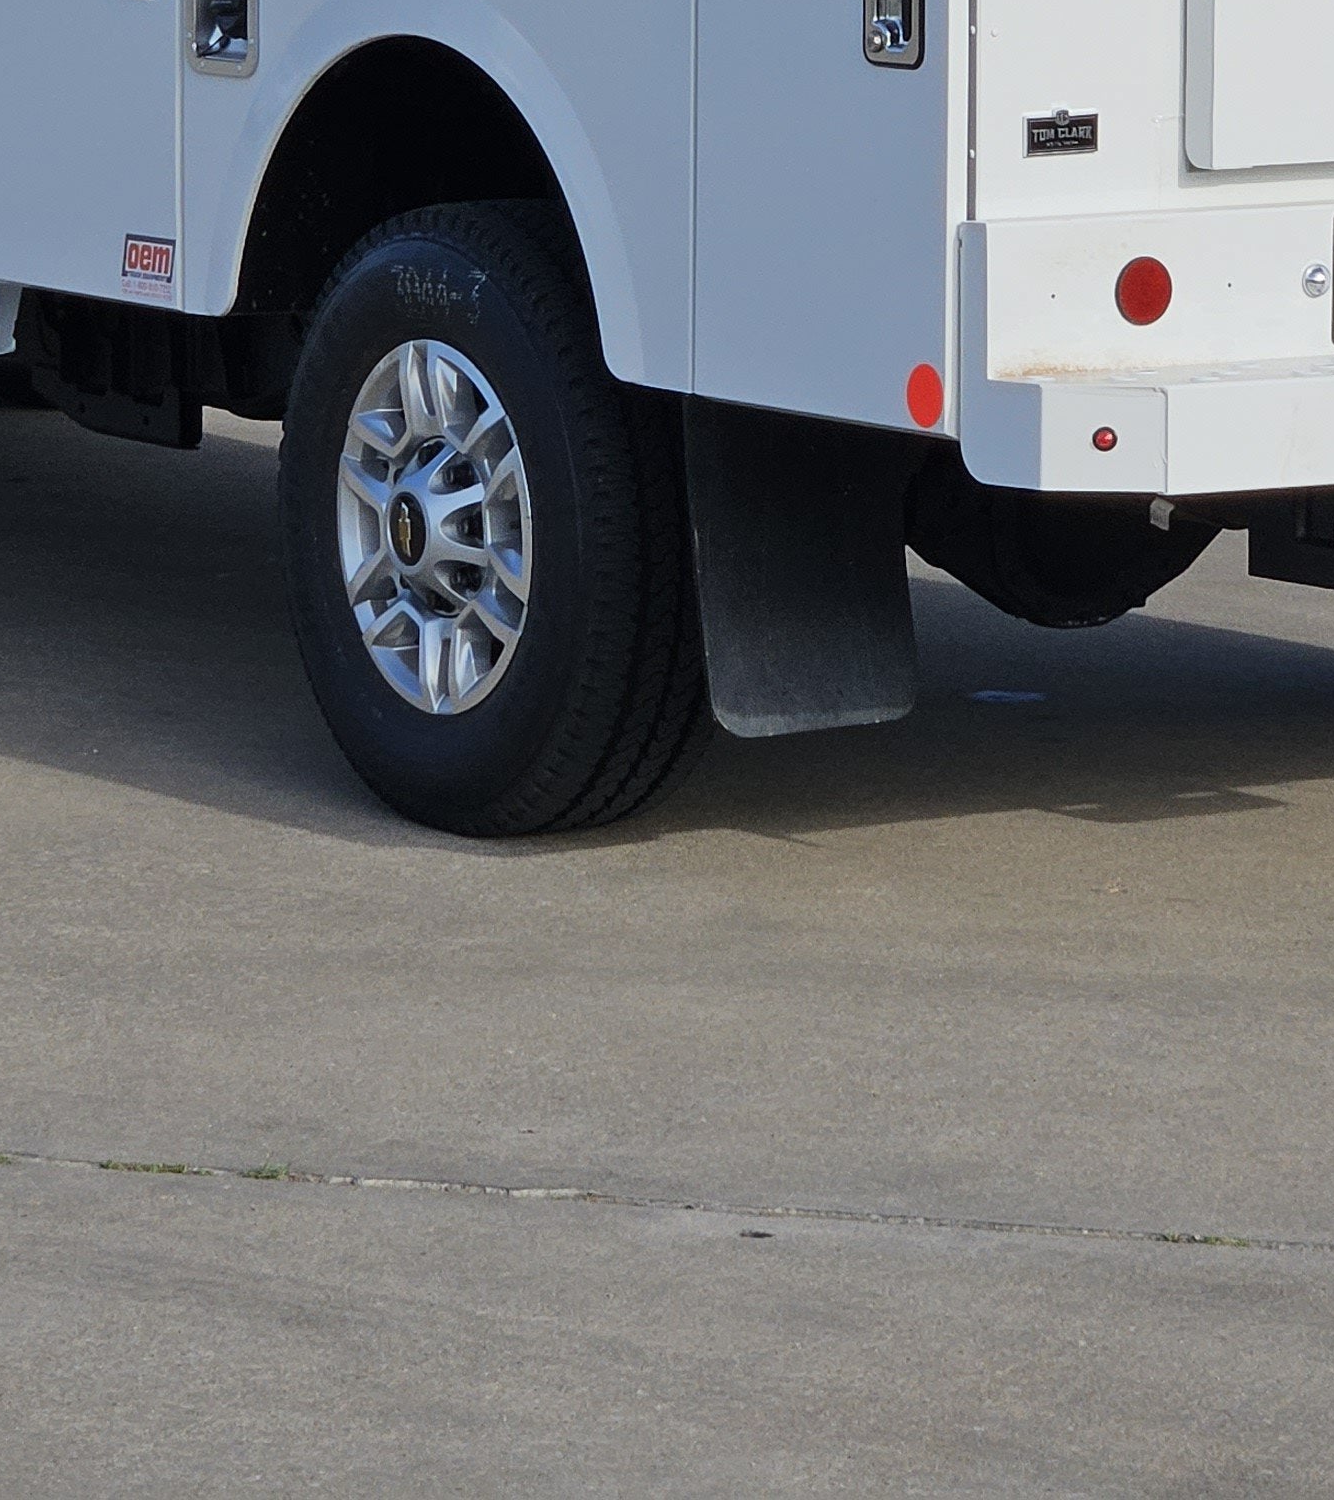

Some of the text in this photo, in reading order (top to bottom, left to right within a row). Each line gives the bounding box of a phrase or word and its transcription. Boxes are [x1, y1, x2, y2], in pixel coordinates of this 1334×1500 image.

[1031, 125, 1093, 143] TOM CLARK
[127, 242, 170, 275] oem
